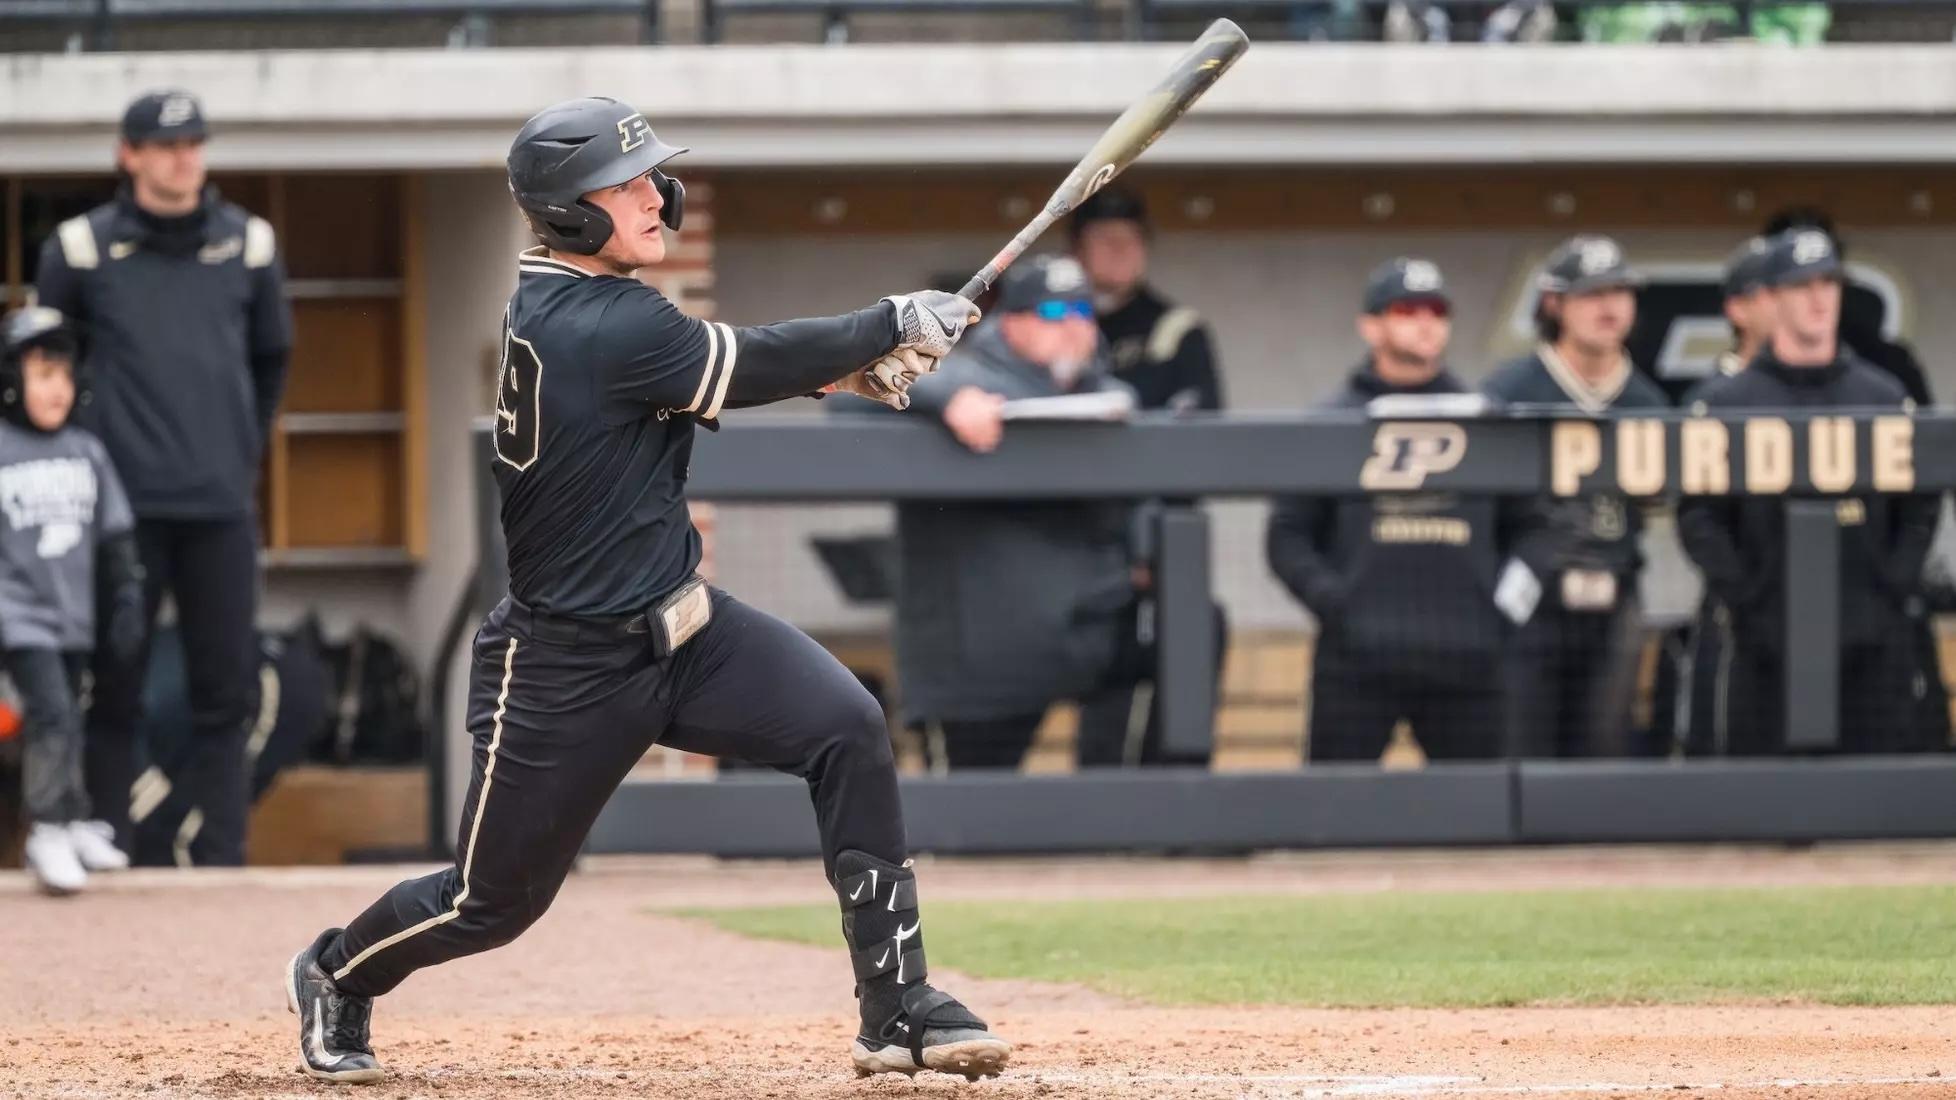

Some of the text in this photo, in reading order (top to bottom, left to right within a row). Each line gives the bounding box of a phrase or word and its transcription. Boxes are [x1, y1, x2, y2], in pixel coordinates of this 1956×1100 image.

[616, 113, 650, 153] P
[494, 302, 543, 472] 9
[1360, 421, 1468, 490] P
[1551, 416, 1915, 496] PURDUE
